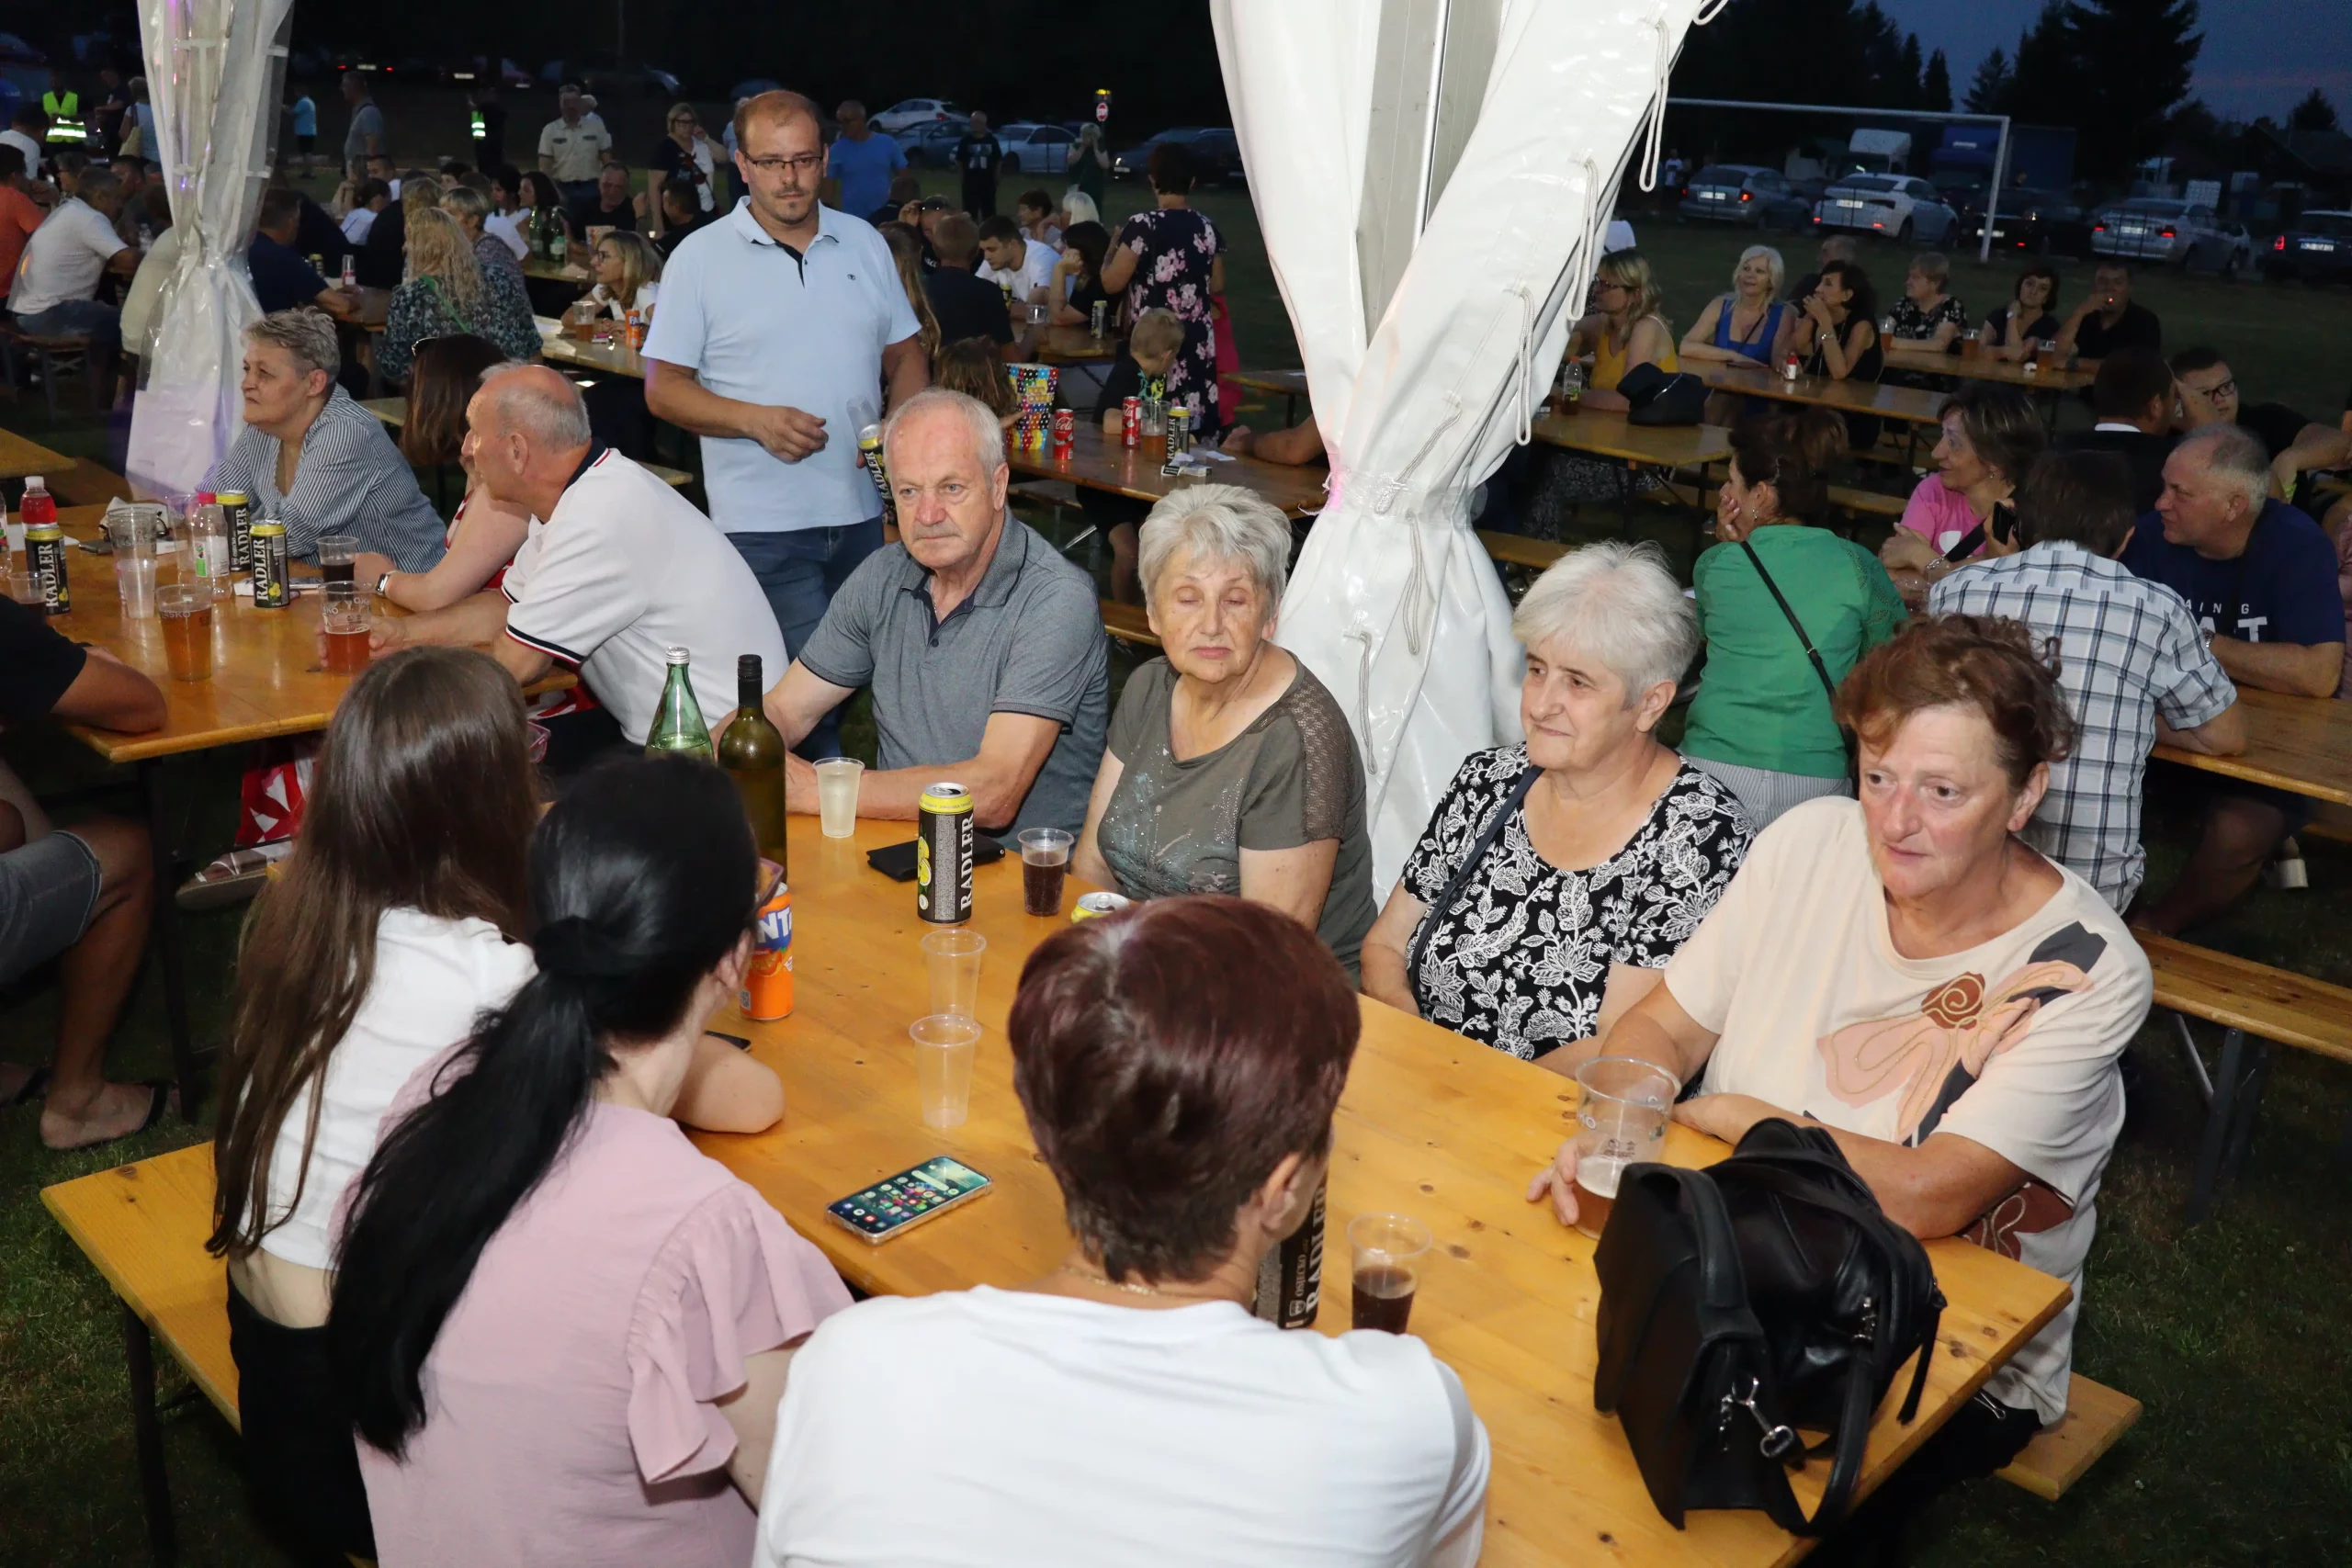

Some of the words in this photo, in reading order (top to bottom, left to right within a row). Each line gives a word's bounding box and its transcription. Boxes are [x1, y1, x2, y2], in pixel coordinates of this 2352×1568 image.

[1166, 418, 1176, 459] RADLER
[865, 451, 894, 500] RADLER
[235, 507, 250, 566] RADLER
[38, 543, 60, 607] RADLER
[253, 538, 269, 601] RADLER
[960, 813, 974, 911] RADLER
[757, 906, 792, 943] NT
